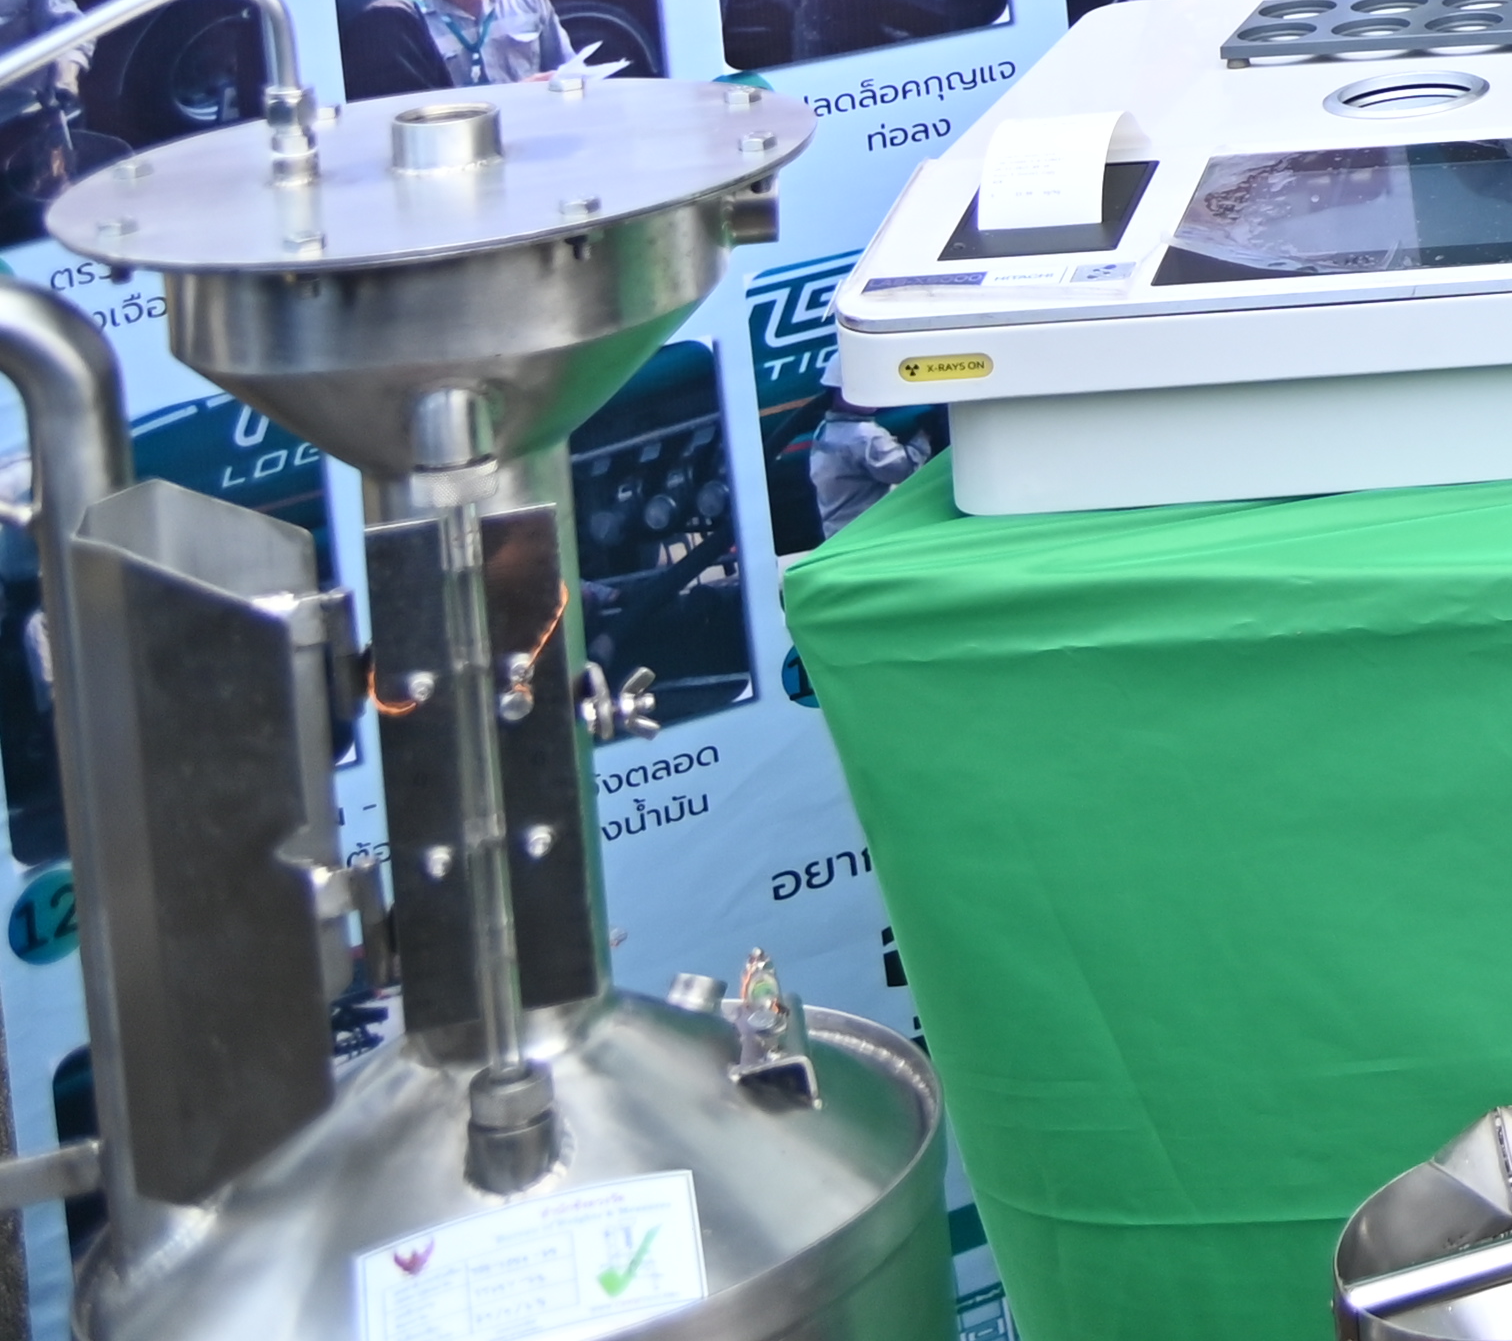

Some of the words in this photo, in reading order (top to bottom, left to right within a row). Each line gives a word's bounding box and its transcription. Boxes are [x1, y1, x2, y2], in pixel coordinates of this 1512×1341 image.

[801, 55, 1018, 119] ลดล็อคกุญแจ
[866, 113, 952, 152] ท่อลง
[927, 361, 966, 373] X-RAYS
[967, 360, 985, 370] ON
